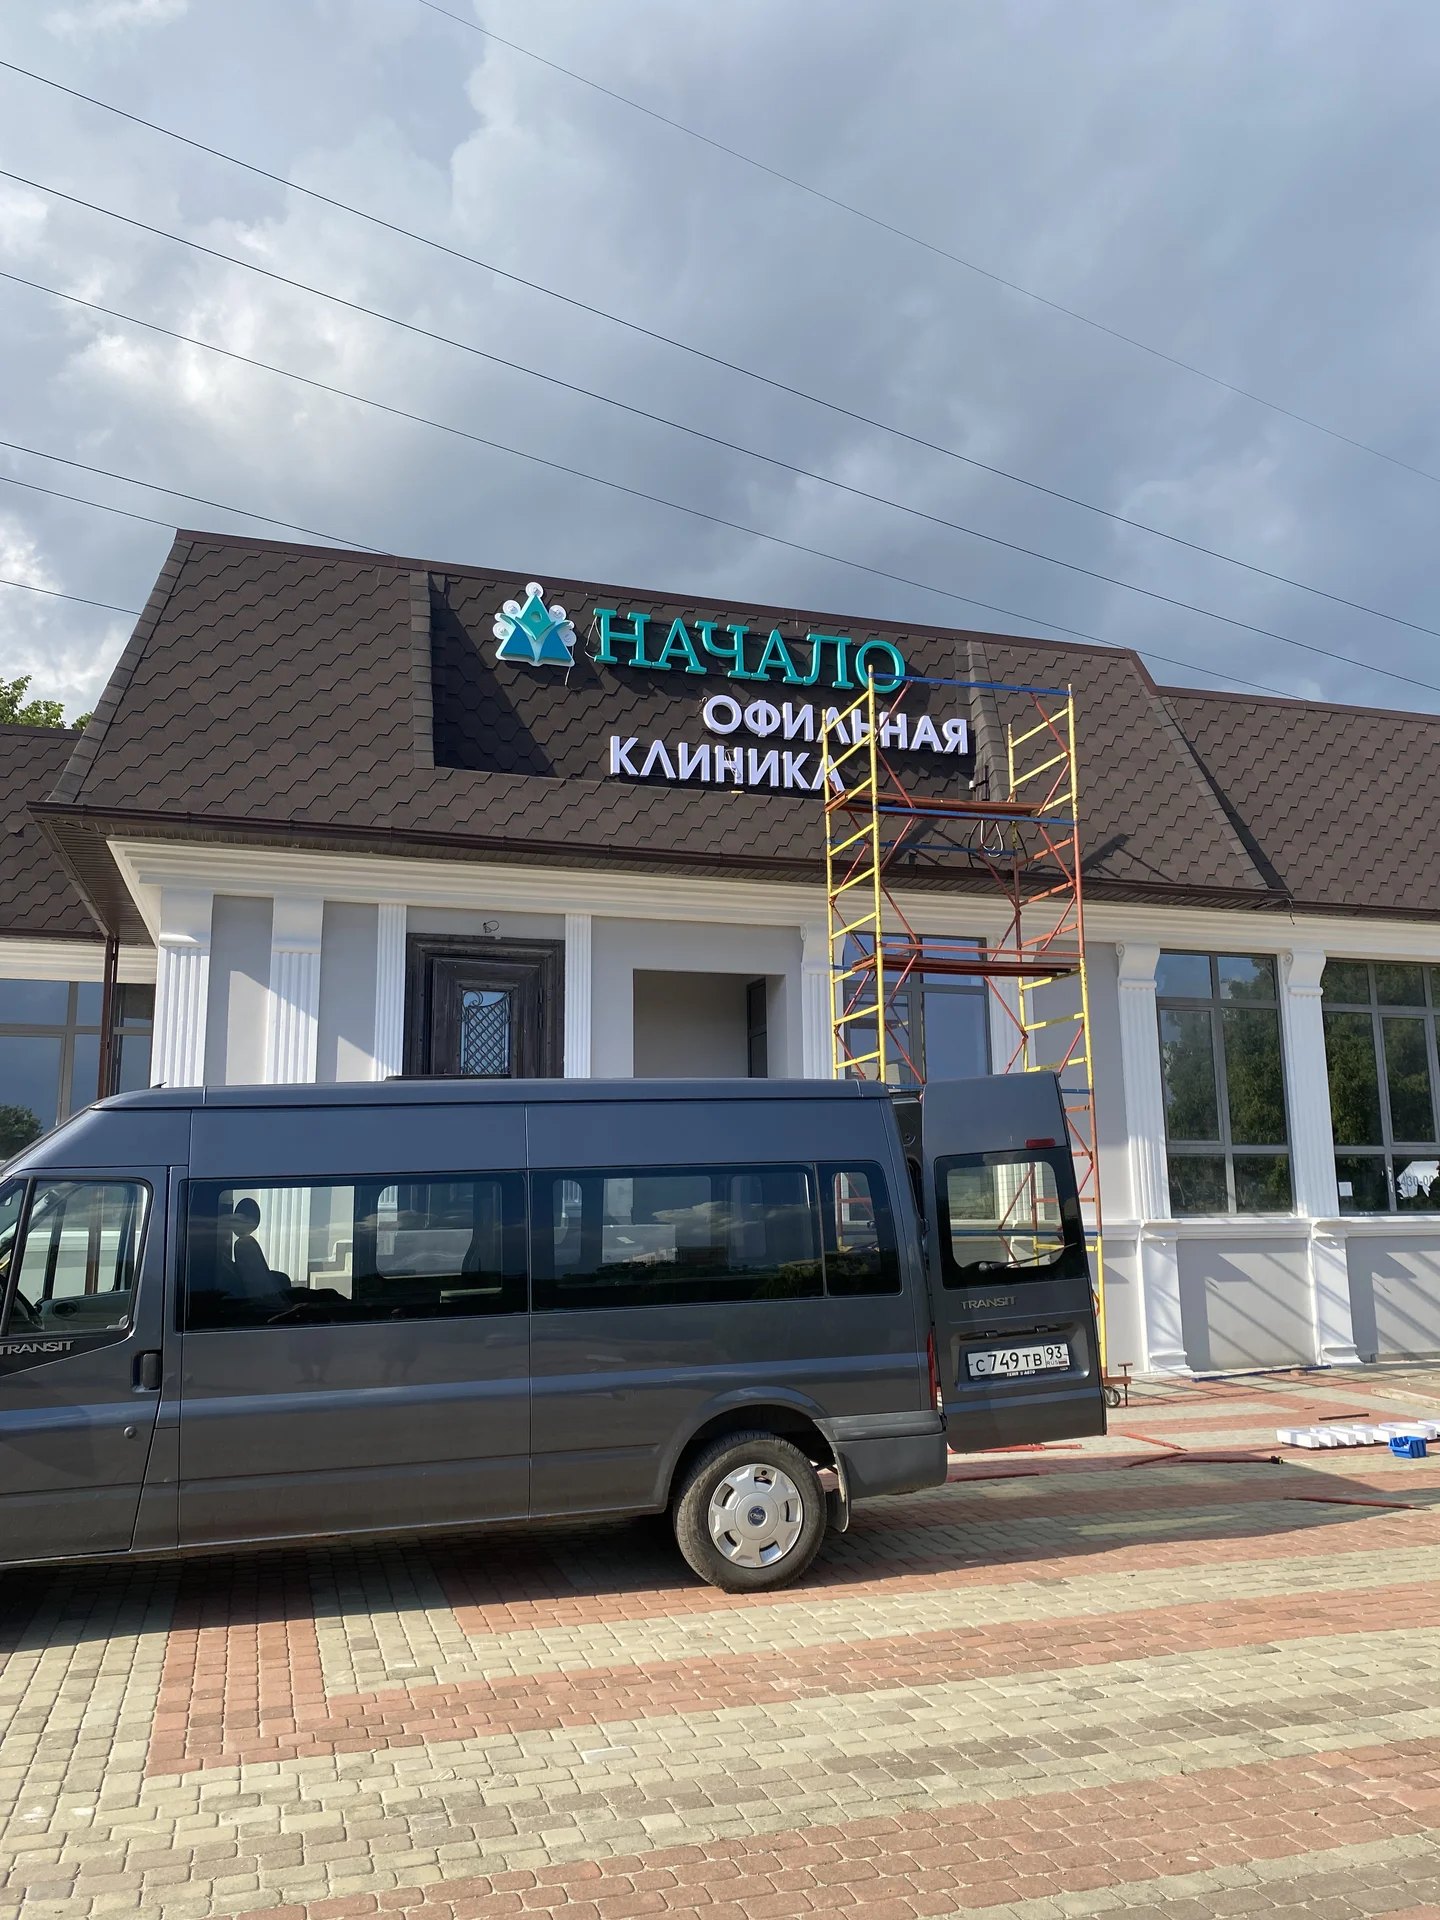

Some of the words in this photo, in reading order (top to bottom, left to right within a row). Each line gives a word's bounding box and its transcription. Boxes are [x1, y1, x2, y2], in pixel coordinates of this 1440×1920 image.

[593, 608, 906, 694] НАЧАЛО
[609, 735, 845, 792] КЛИНИКА
[961, 1296, 1016, 1310] TRANSIT
[0, 1341, 74, 1355] TRANSIT
[1046, 1346, 1062, 1360] 93
